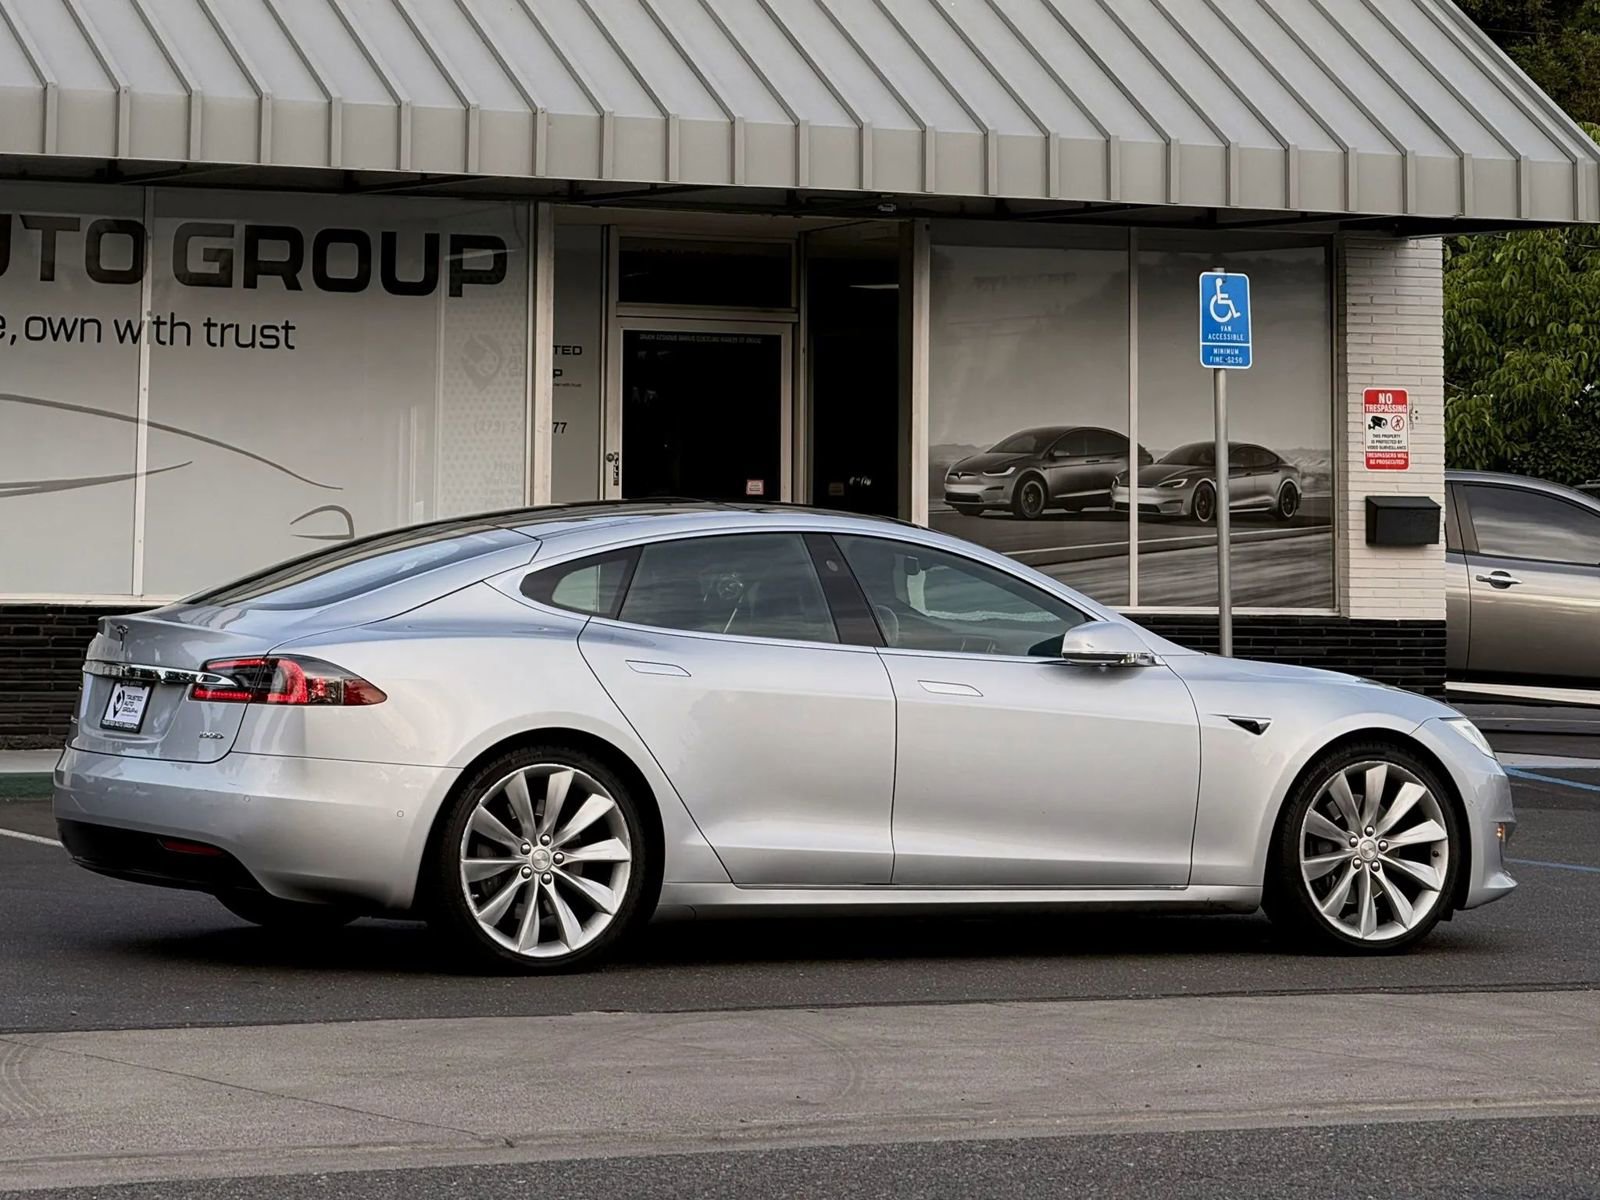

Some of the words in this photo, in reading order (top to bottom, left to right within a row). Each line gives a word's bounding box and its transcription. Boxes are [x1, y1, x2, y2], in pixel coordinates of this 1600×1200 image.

[0, 212, 148, 285] TO
[172, 221, 508, 298] GROUP
[24, 315, 102, 344] own
[203, 316, 296, 350] trust
[1365, 404, 1407, 413] TRESPASSING
[1378, 392, 1392, 404] NO
